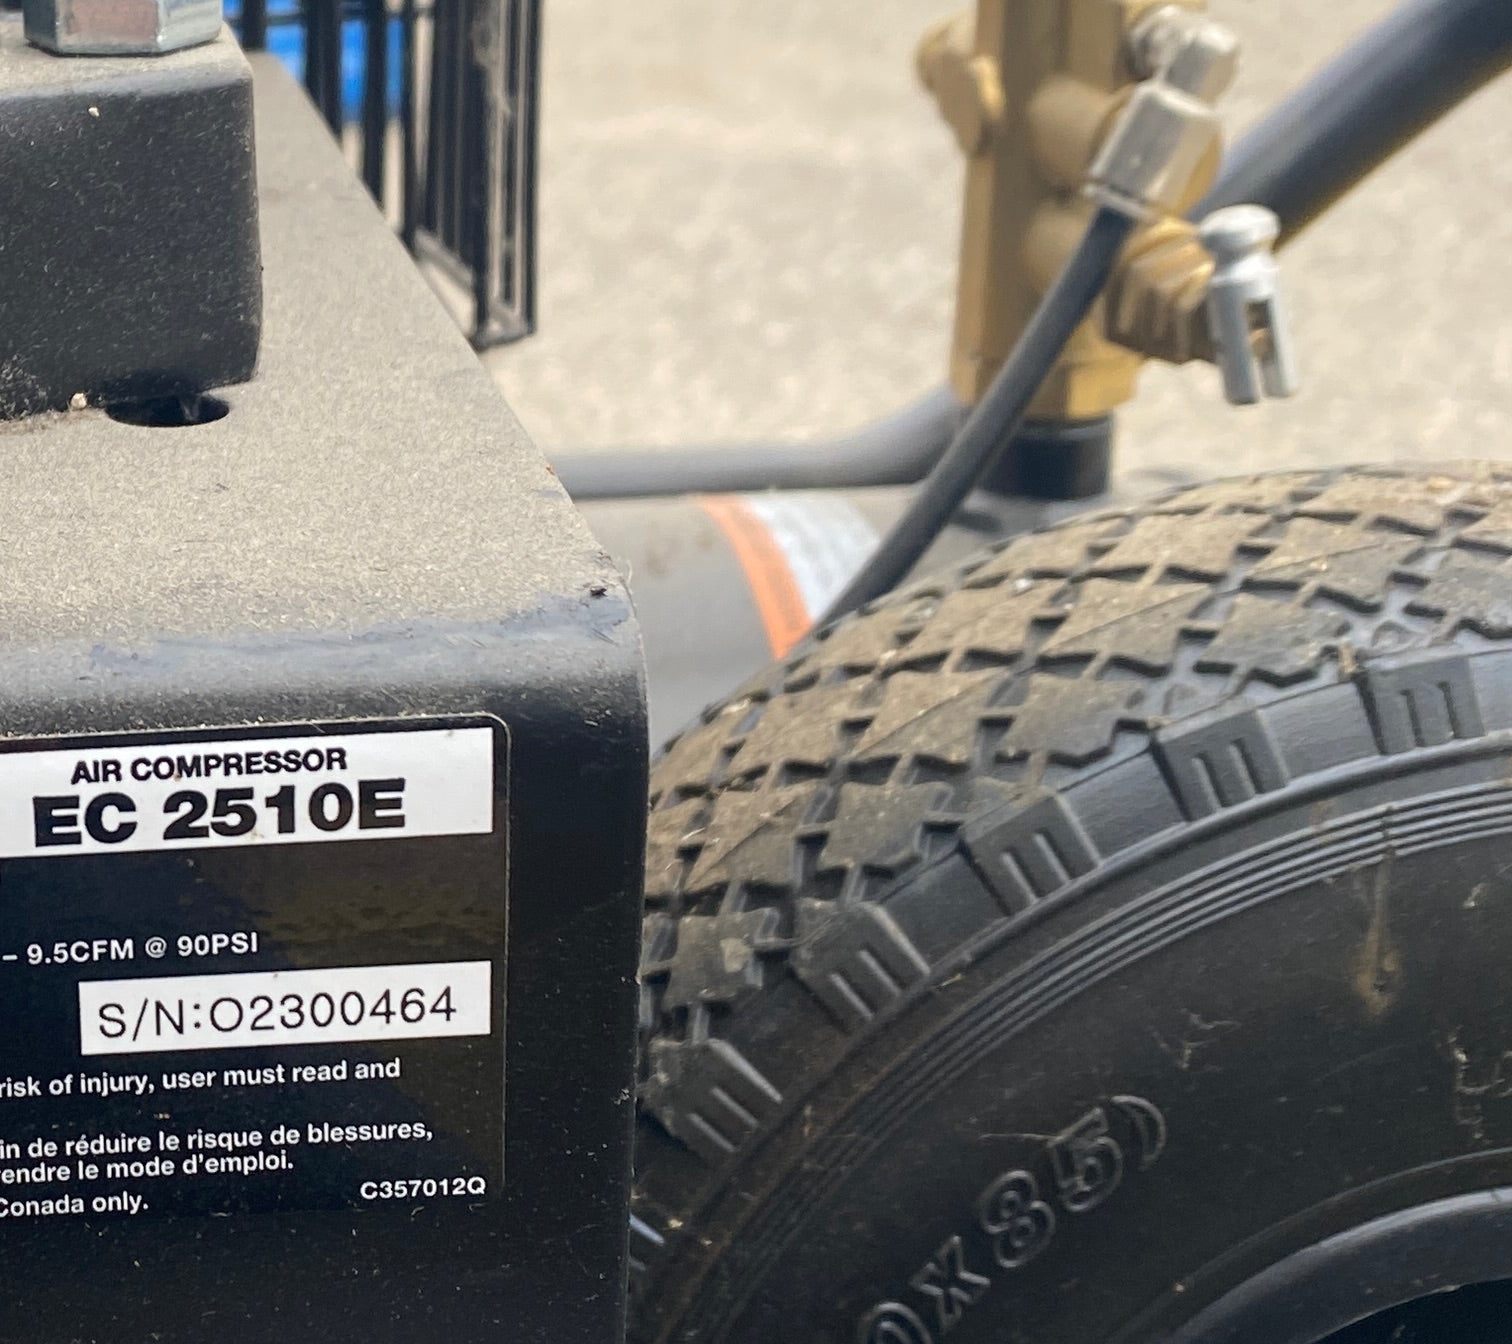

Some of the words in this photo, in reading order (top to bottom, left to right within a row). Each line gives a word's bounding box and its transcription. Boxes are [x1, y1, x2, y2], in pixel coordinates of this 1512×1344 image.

[71, 759, 122, 785] AIR
[130, 747, 347, 781] COMPRESSOR
[32, 792, 138, 848] EC
[163, 778, 406, 840] 2510E
[27, 939, 134, 965] 9.5CFM
[145, 937, 167, 958] @
[177, 932, 257, 956] 90PSI
[49, 1074, 73, 1095] of
[80, 1072, 154, 1097] injury,
[163, 1071, 217, 1089] user
[224, 1064, 285, 1086] must
[293, 1060, 347, 1082] read
[355, 1057, 400, 1079] and
[28, 1137, 58, 1158] de
[65, 1133, 151, 1156] réduire
[159, 1131, 180, 1151] le
[188, 1129, 263, 1152] risque
[270, 1125, 300, 1145] de
[308, 1122, 432, 1143] blessures,
[78, 1160, 99, 1180] le
[107, 1156, 175, 1178] mode
[182, 1149, 293, 1175] d'emploi.
[92, 1191, 148, 1214] only.
[360, 1176, 486, 1199] C357012Q
